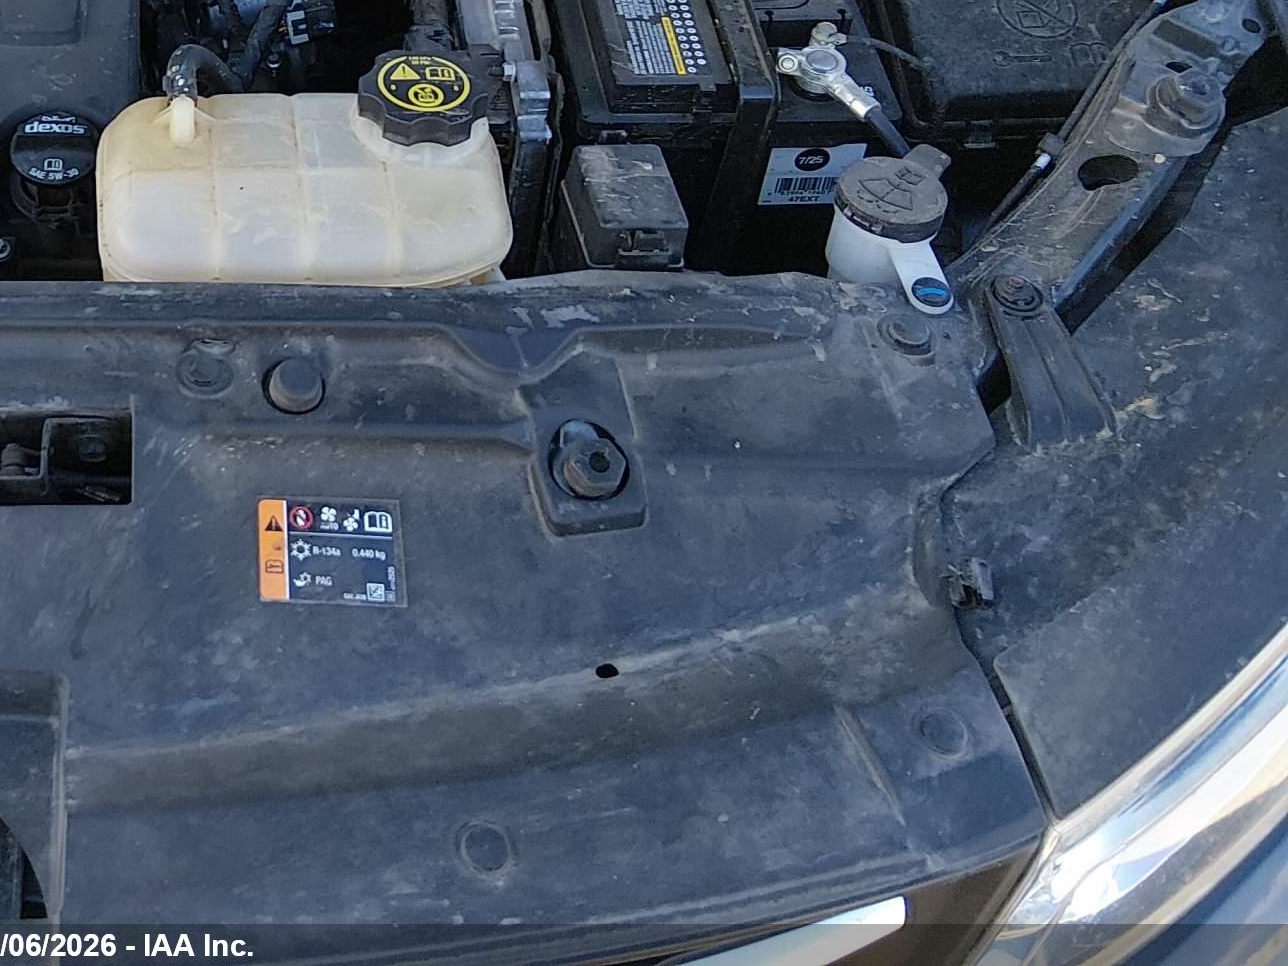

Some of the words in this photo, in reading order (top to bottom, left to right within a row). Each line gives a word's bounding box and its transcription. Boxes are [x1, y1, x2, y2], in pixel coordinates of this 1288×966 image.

[24, 121, 88, 134] dexos
[798, 155, 825, 165] 7/25
[28, 167, 47, 180] SAE
[315, 575, 333, 587] PAG
